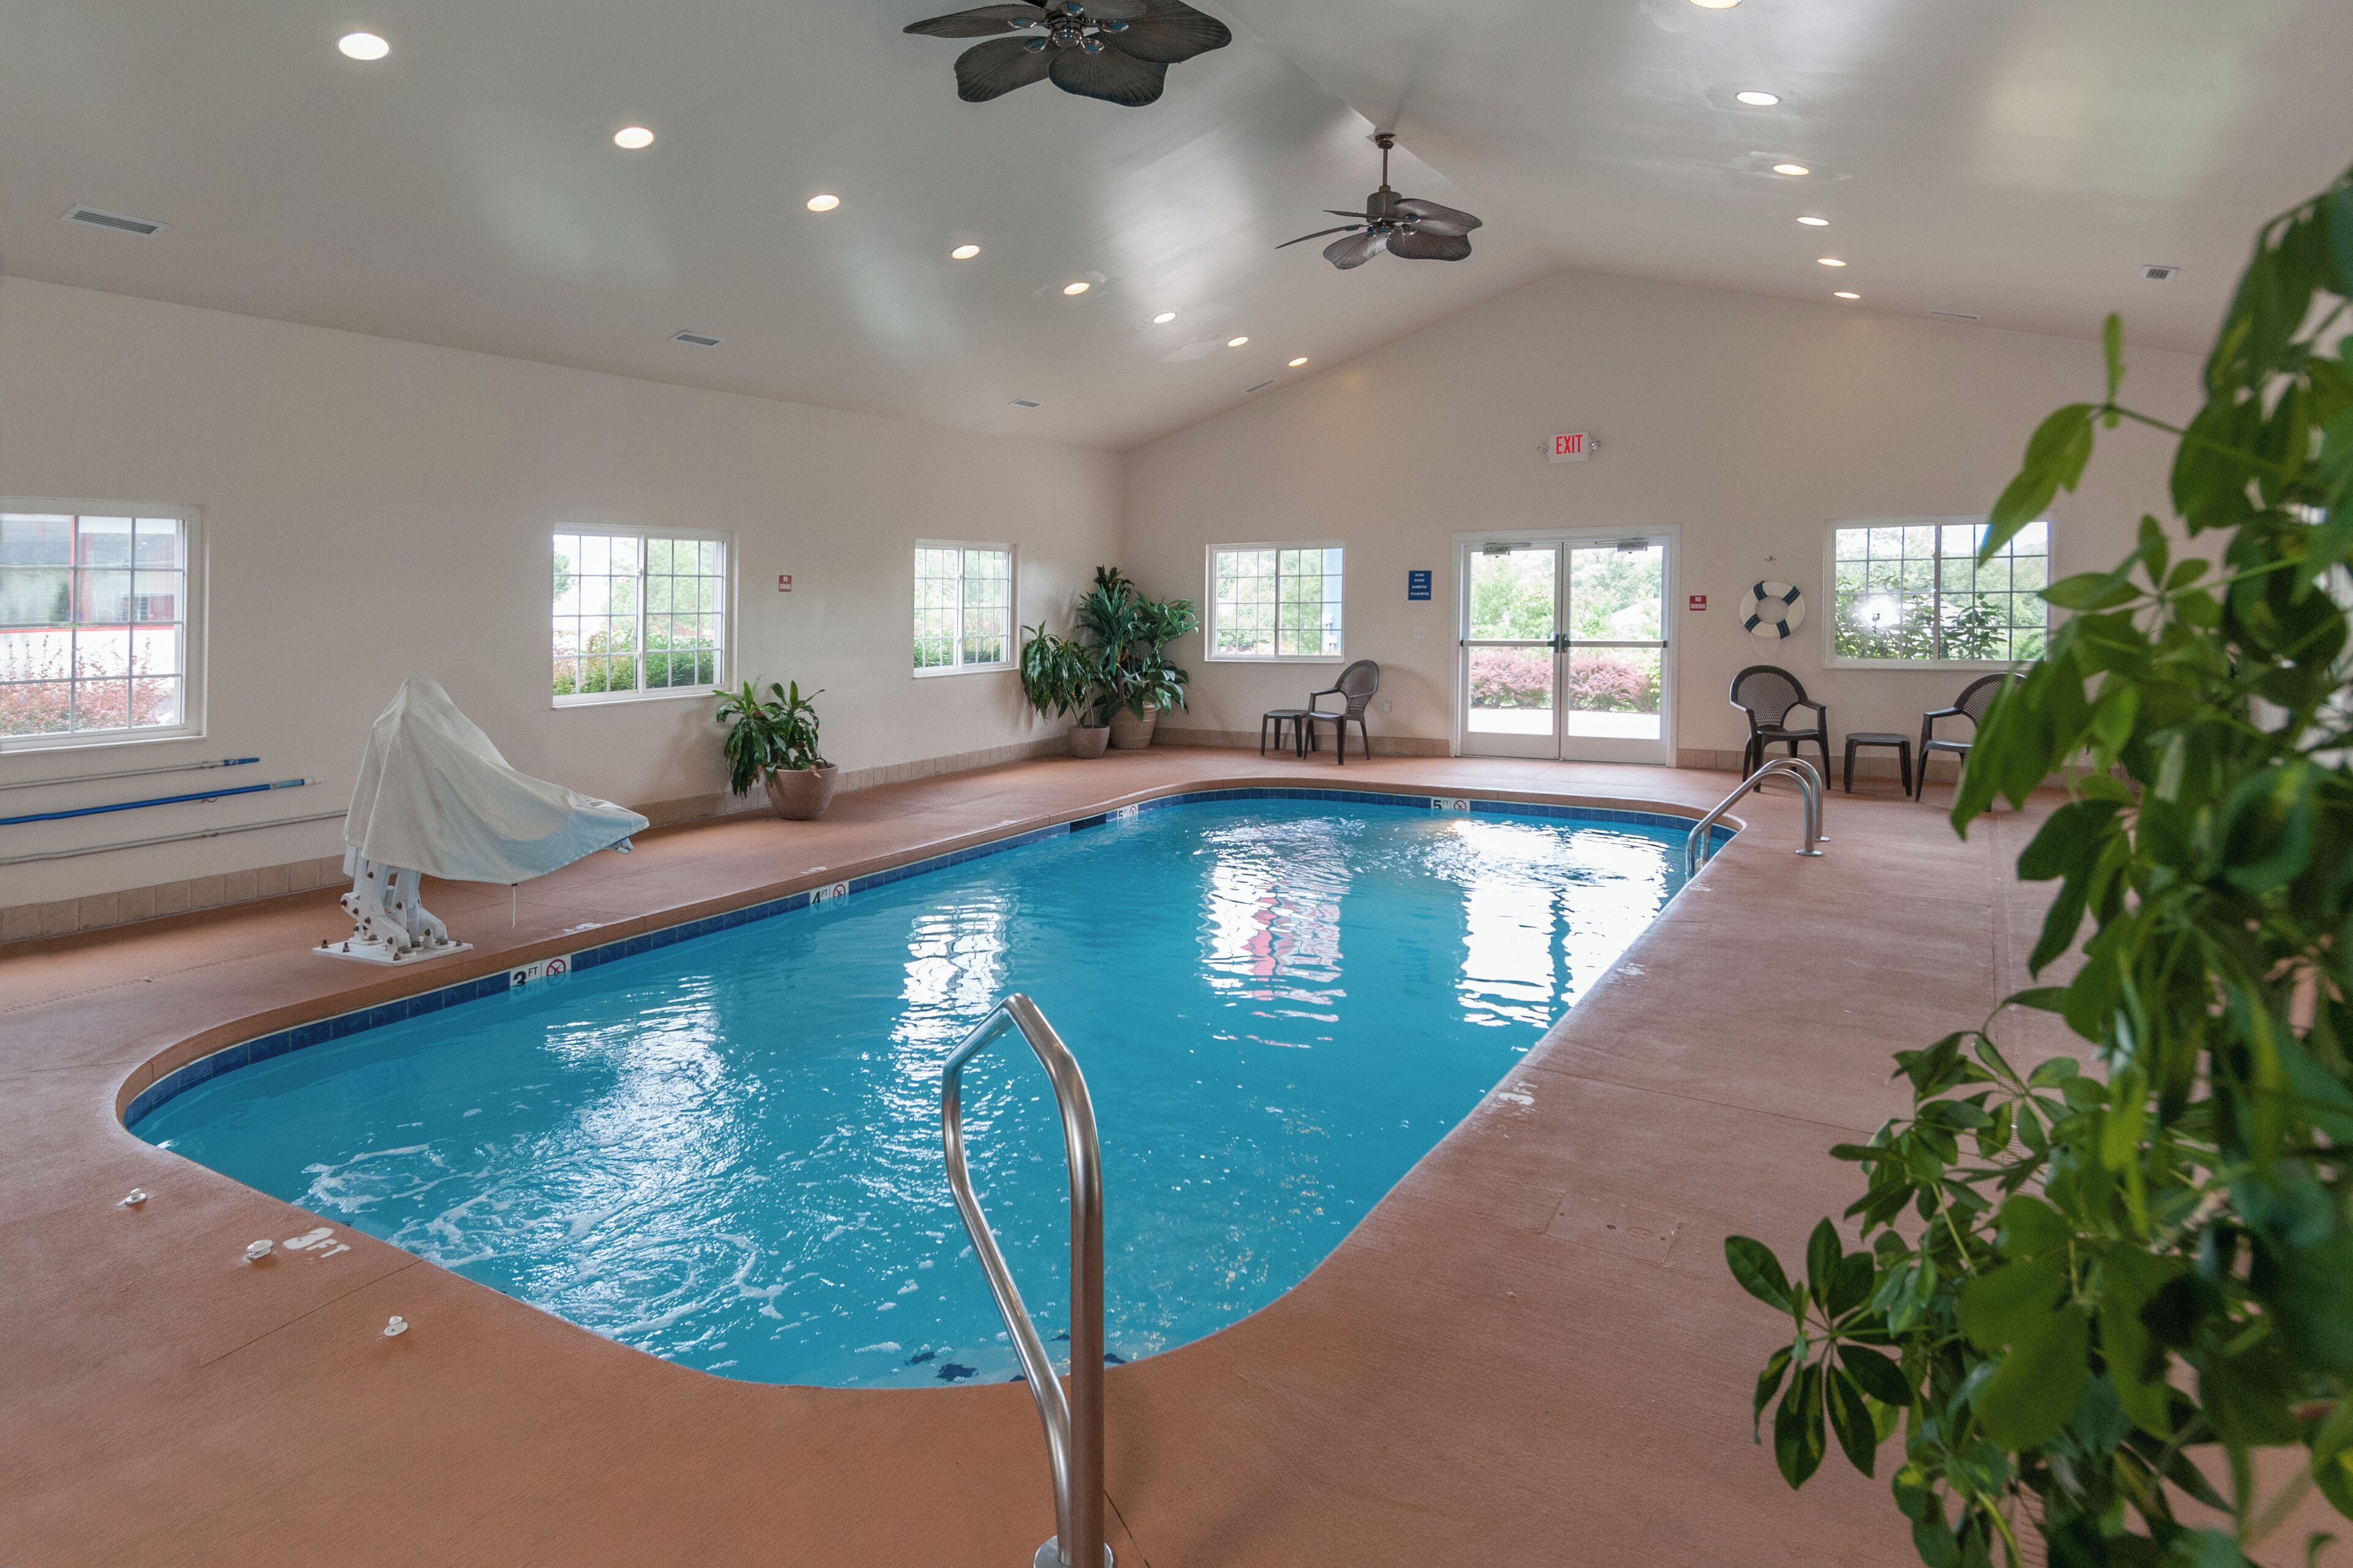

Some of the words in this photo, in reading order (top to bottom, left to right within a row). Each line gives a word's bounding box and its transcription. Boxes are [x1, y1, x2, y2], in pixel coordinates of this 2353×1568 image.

[1556, 434, 1583, 454] EXIT
[1433, 800, 1442, 809] 5
[812, 891, 820, 904] 4
[513, 971, 527, 987] 3
[528, 966, 538, 977] FT
[1513, 1081, 1539, 1094] FT
[283, 1227, 333, 1249] 3
[306, 1238, 350, 1258] FT
